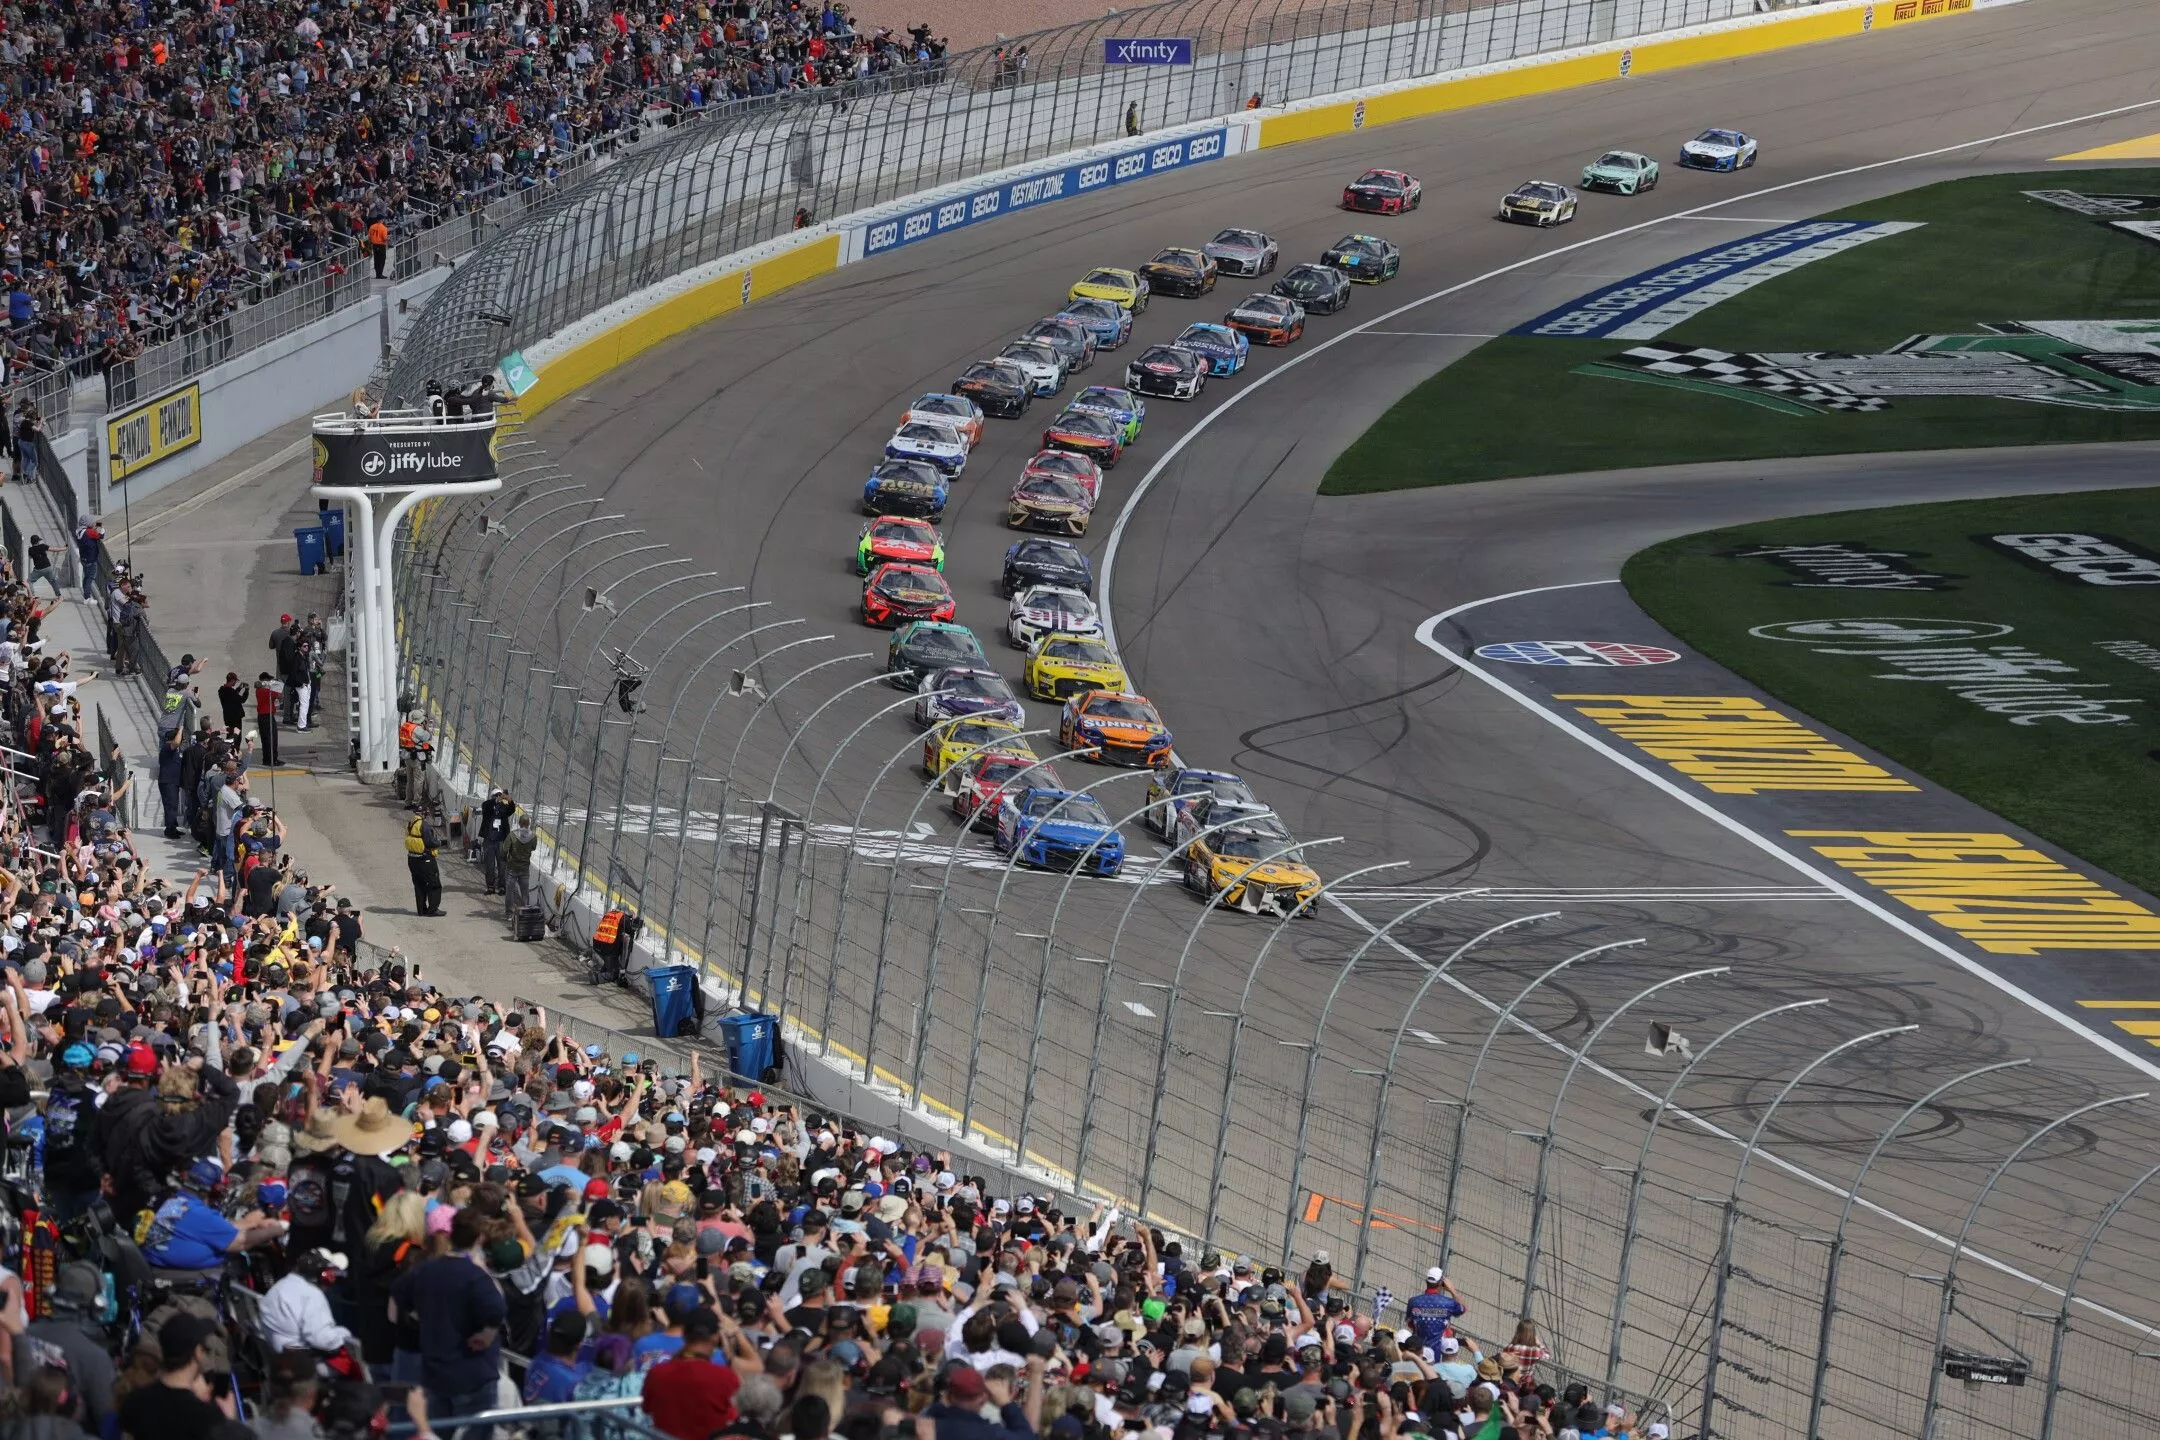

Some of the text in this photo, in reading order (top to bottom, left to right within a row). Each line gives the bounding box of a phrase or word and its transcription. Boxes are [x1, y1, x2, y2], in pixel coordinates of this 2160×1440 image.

[1894, 2, 1918, 21] PIRELLI
[1118, 41, 1178, 63] xfinity
[1152, 143, 1182, 169] GEICO
[1188, 135, 1221, 160] GEICO
[1078, 163, 1109, 189] GEICO
[1115, 153, 1146, 179] GEICO
[1009, 173, 1066, 208] RESTART ZONE
[937, 201, 966, 229] GEICO
[971, 191, 1000, 218] GEICO
[869, 222, 898, 251] GEICO
[903, 212, 932, 240] GEICO
[160, 394, 193, 450] PENNZOIL
[117, 412, 152, 469] PENNZOIL
[1552, 694, 1923, 795] PENNZOIL
[1971, 1372, 2008, 1384] WHELEN
